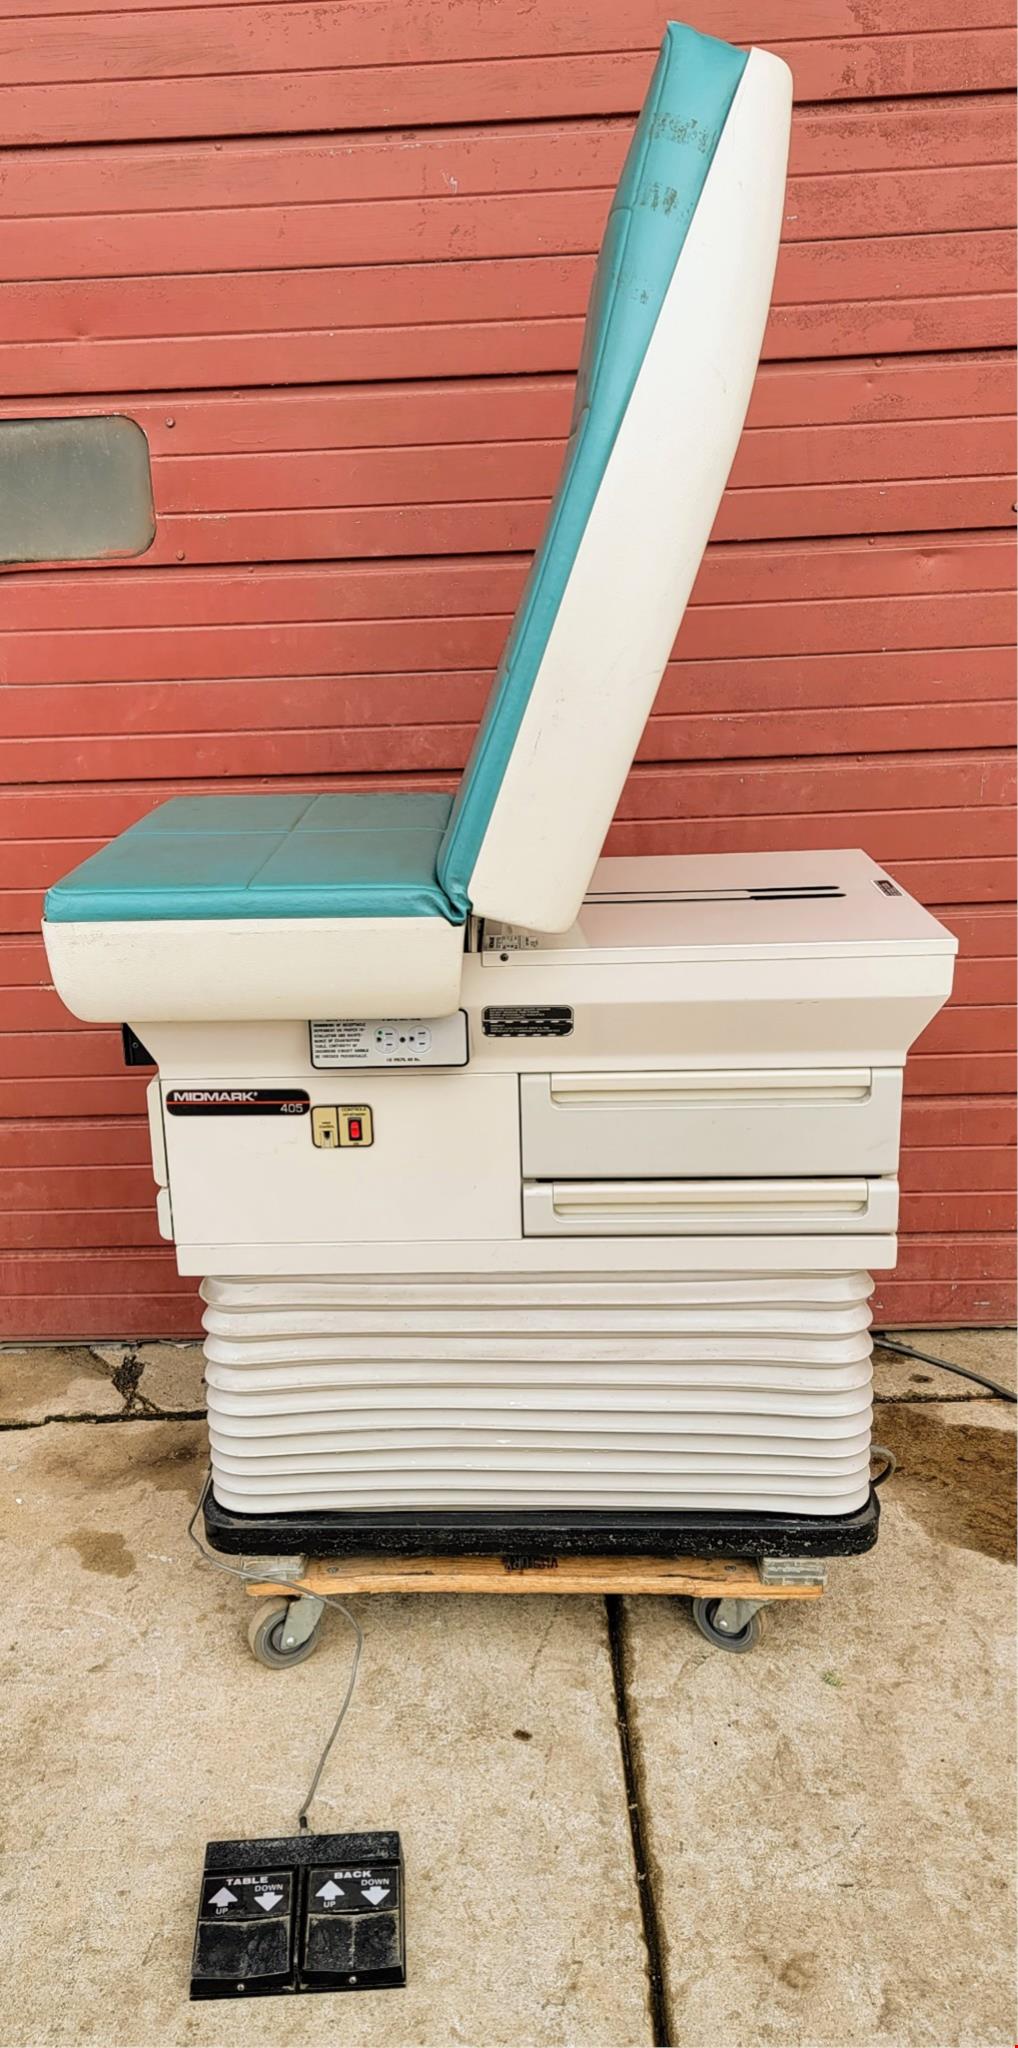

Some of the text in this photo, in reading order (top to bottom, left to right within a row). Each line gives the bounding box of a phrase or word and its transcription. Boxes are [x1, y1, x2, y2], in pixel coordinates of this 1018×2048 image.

[173, 1091, 255, 1102] MIDMARK
[280, 1103, 304, 1113] 405
[334, 1870, 372, 1880] BACK
[226, 1876, 268, 1886] TABLE
[361, 1878, 390, 1886] DOWN
[255, 1884, 283, 1892] DOWN
[323, 1900, 336, 1908] UP
[215, 1907, 229, 1915] UP
